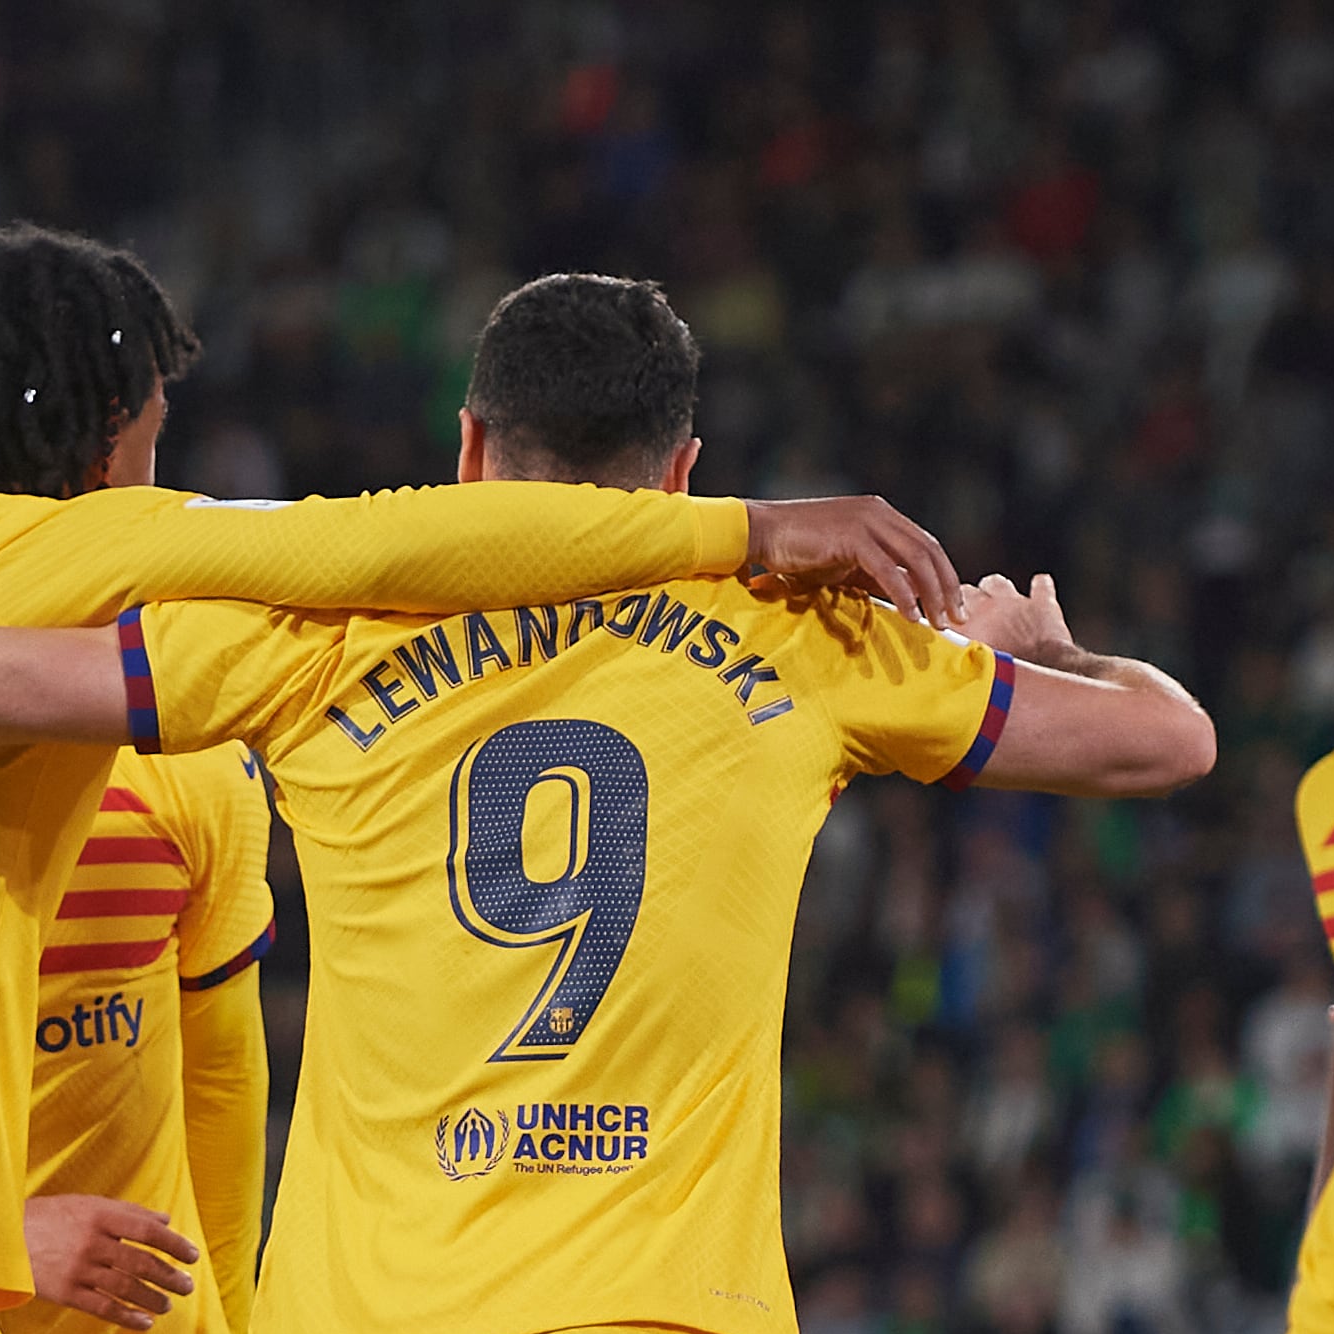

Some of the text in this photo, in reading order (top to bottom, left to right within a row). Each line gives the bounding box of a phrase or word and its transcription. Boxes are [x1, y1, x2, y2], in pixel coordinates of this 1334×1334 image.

[446, 719, 649, 1064] 9
[517, 1103, 649, 1132] UNHCR
[513, 1133, 648, 1161] ACNUR
[514, 1163, 534, 1173] The
[537, 1163, 554, 1173] UN
[557, 1164, 603, 1176] Refugee
